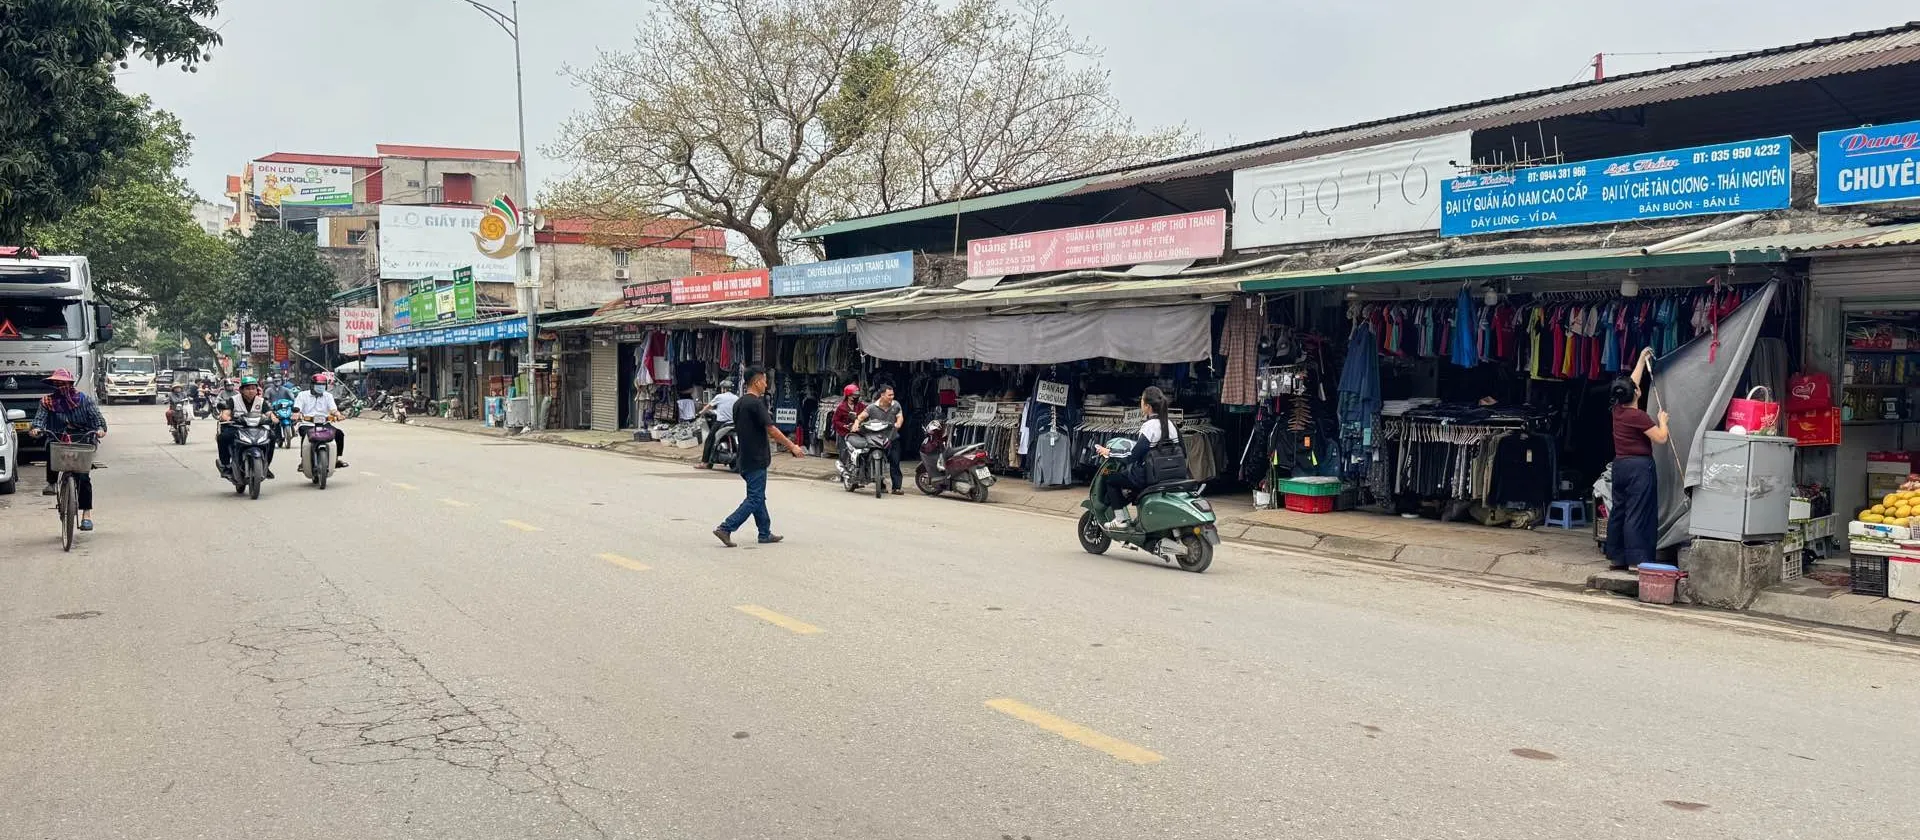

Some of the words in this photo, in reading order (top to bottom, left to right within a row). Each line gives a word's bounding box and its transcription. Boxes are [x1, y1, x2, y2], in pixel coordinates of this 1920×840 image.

[1693, 152, 1709, 164] ĐT:
[1711, 148, 1730, 162] 035
[1732, 147, 1752, 159] 950
[1754, 144, 1781, 157] 4232
[1540, 171, 1557, 182] 0944
[1558, 169, 1571, 179] 381
[1602, 186, 1618, 206] ĐẠI
[1619, 179, 1630, 200] LÝ
[1631, 177, 1650, 198] CHÈ
[1651, 177, 1669, 196] TÂN
[1672, 175, 1709, 195] CƯƠNG
[1718, 167, 1740, 190] THÁI
[1742, 165, 1785, 188] NGUYÊN
[1446, 201, 1460, 217] ĐẠI
[1462, 193, 1473, 212] LÝ
[1474, 190, 1500, 211] QUẦN
[1501, 189, 1516, 208] ÁO
[1518, 191, 1540, 206] NAM
[1542, 187, 1565, 204] CAO
[1566, 180, 1588, 200] CẤP
[1639, 201, 1660, 213] BÁN
[1663, 198, 1692, 212] BUÔN
[1703, 196, 1726, 208] BÁN
[1729, 193, 1740, 206] LẺ
[1096, 228, 1112, 240] NAM
[1114, 226, 1128, 237] CAO
[1130, 223, 1145, 236] CẤP
[1188, 214, 1216, 228] TRANG
[1471, 216, 1490, 228] DÂY
[1493, 213, 1520, 226] LƯNG
[1529, 210, 1540, 222] VÍ
[1542, 211, 1557, 222] DA
[974, 240, 1008, 256] Quảng
[1009, 236, 1032, 252] Hậu
[866, 260, 885, 272] TRANG
[886, 258, 900, 269] NAM
[345, 319, 374, 330] XUÂN
